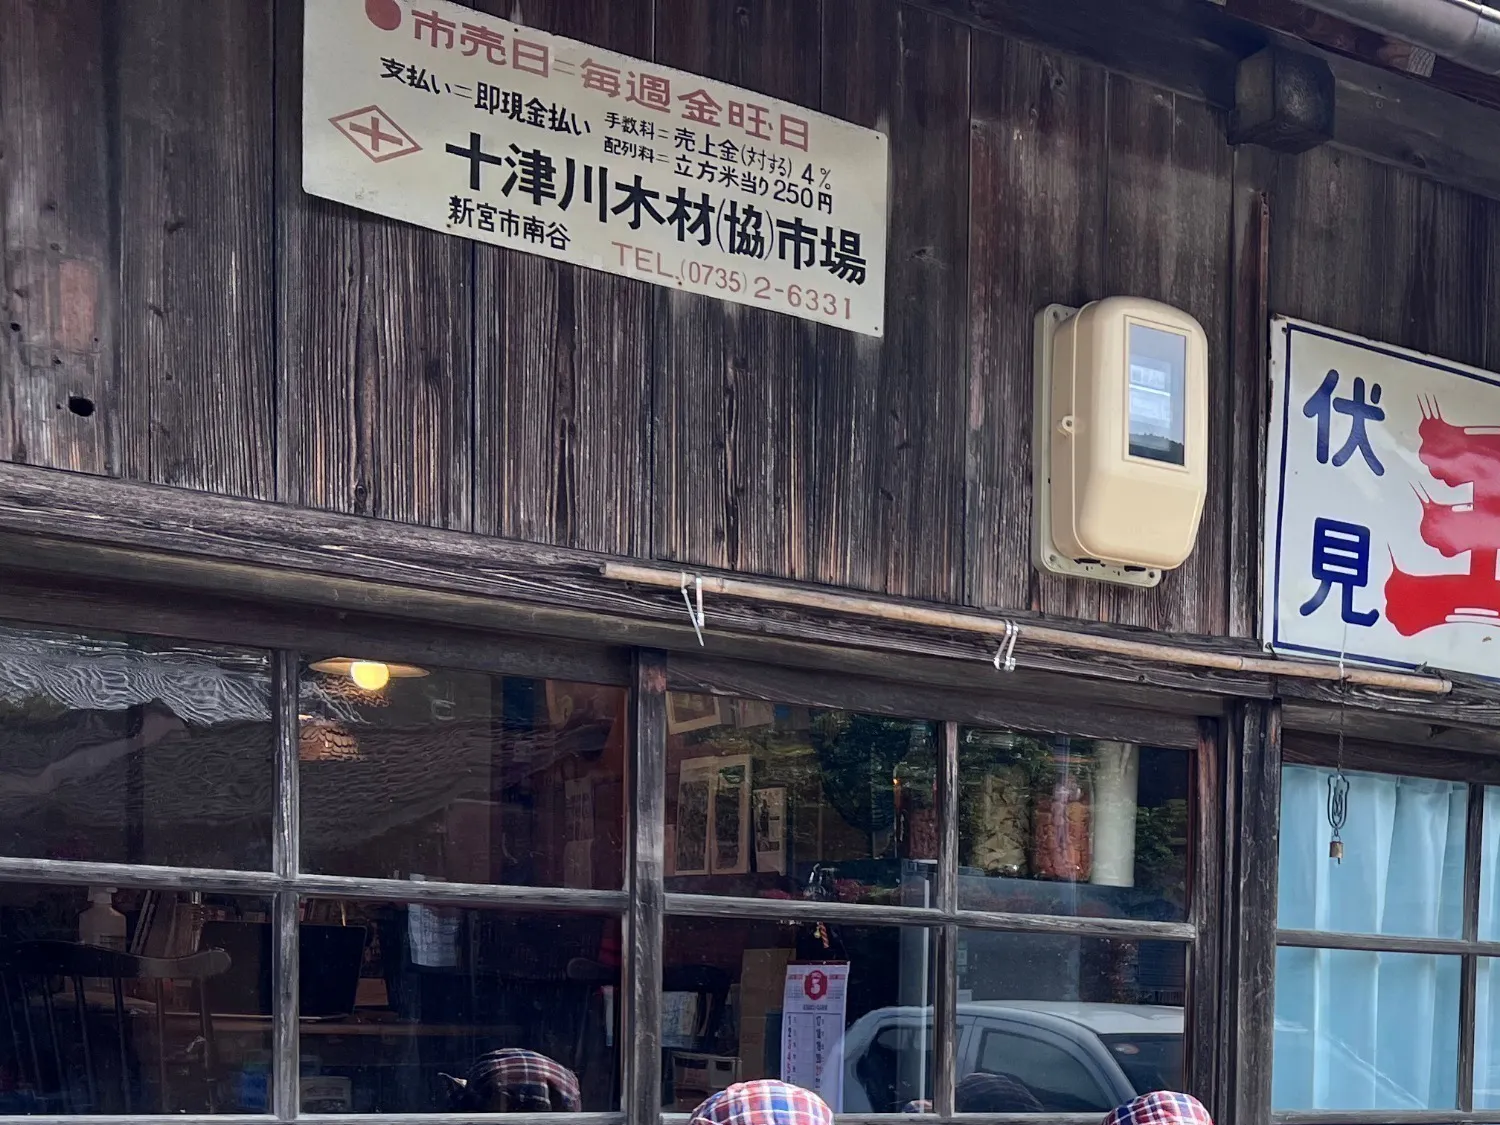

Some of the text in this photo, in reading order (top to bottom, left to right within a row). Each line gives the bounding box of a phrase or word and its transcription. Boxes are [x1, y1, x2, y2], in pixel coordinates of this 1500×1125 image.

[445, 132, 866, 285] 十津川木材(協)市場
[448, 195, 571, 250] 新宮市南谷
[1299, 368, 1386, 627] 伏見
